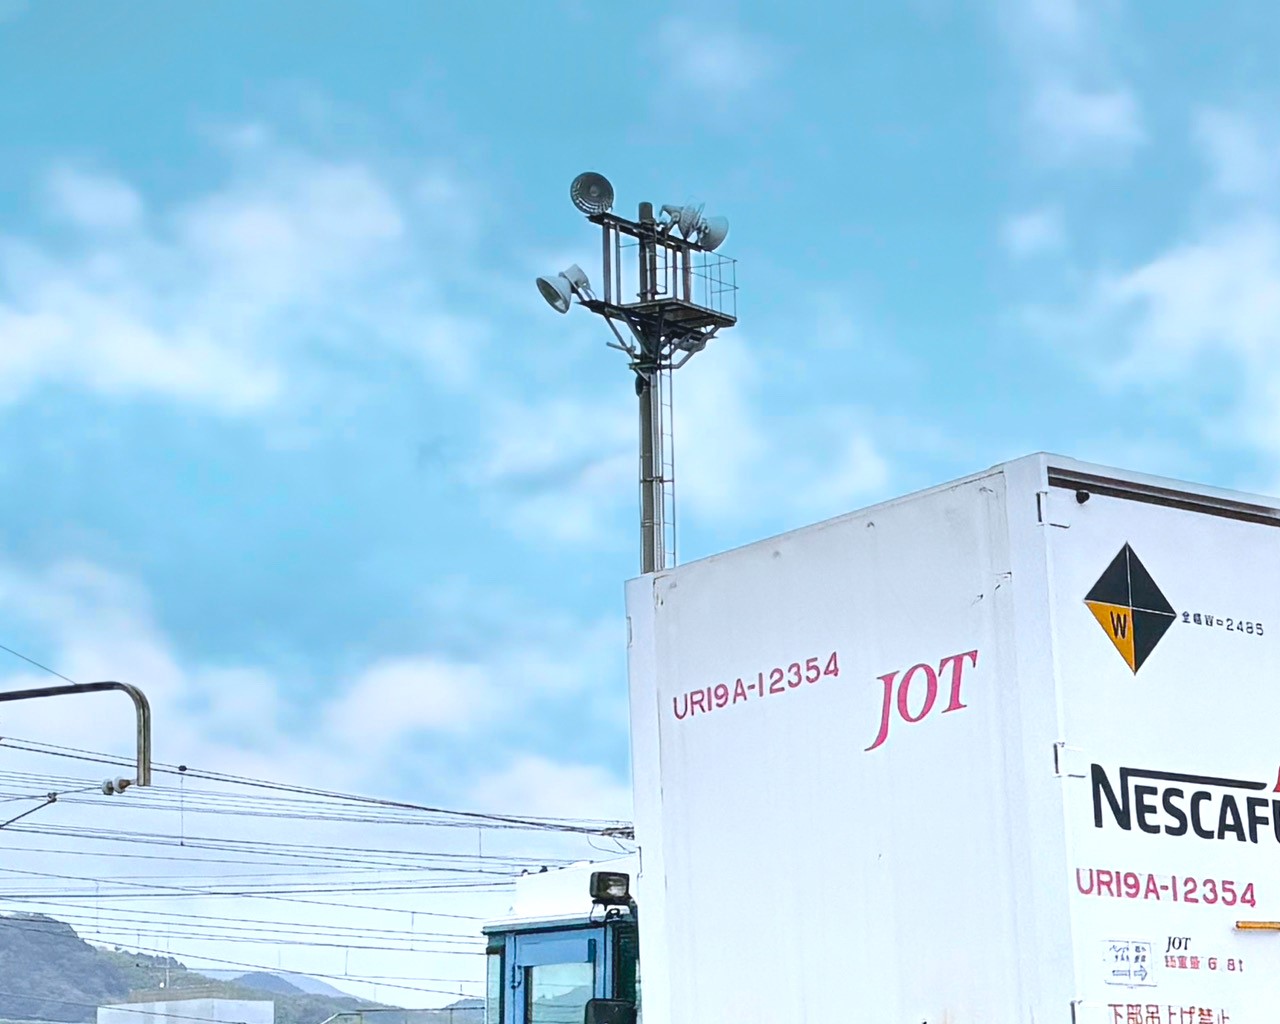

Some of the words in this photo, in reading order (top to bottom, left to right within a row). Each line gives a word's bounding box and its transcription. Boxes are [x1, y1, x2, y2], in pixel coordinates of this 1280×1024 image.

[1110, 611, 1127, 639] W
[673, 651, 839, 719] UR19A-12354
[864, 650, 978, 752] JOT
[1076, 867, 1256, 907] UR19A-12354
[1166, 936, 1191, 953] JOT
